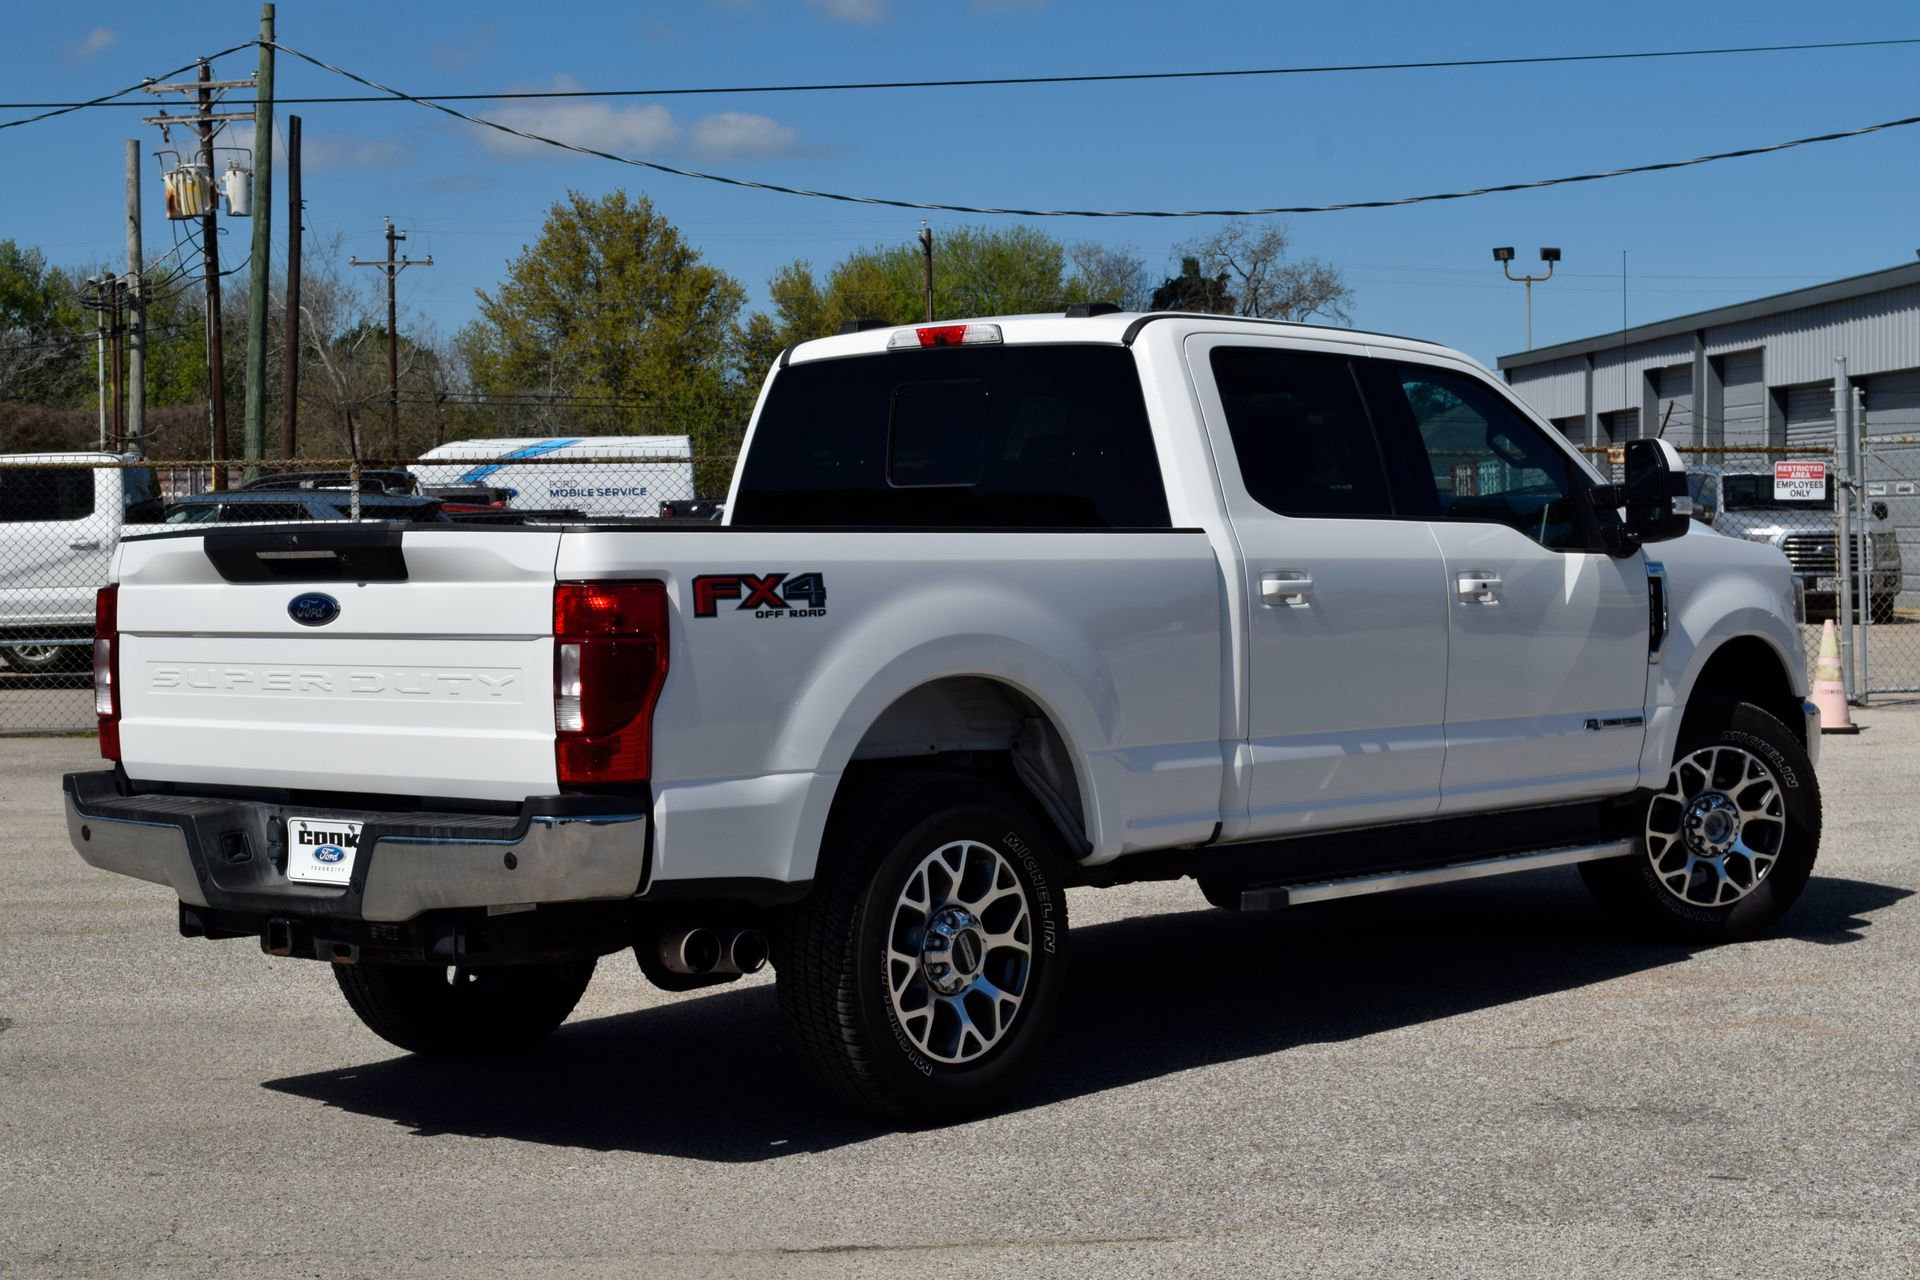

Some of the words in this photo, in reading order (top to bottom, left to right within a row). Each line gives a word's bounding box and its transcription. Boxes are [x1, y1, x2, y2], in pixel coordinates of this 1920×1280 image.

[550, 488, 594, 497] MOBILE
[597, 487, 648, 496] SERVICE
[1776, 481, 1824, 489] EMPLOYEES
[1790, 489, 1811, 497] ONLY
[692, 572, 827, 619] FX4
[296, 599, 326, 618] Ford
[755, 609, 784, 619] OFF
[789, 608, 827, 618] ROAD
[152, 667, 333, 692] SUPER
[350, 672, 515, 697] DUTY
[1720, 730, 1799, 788] MICHELIN
[319, 847, 340, 861] Ford
[1002, 832, 1056, 954] MICHELIN
[880, 949, 934, 1077] MICHELIN
